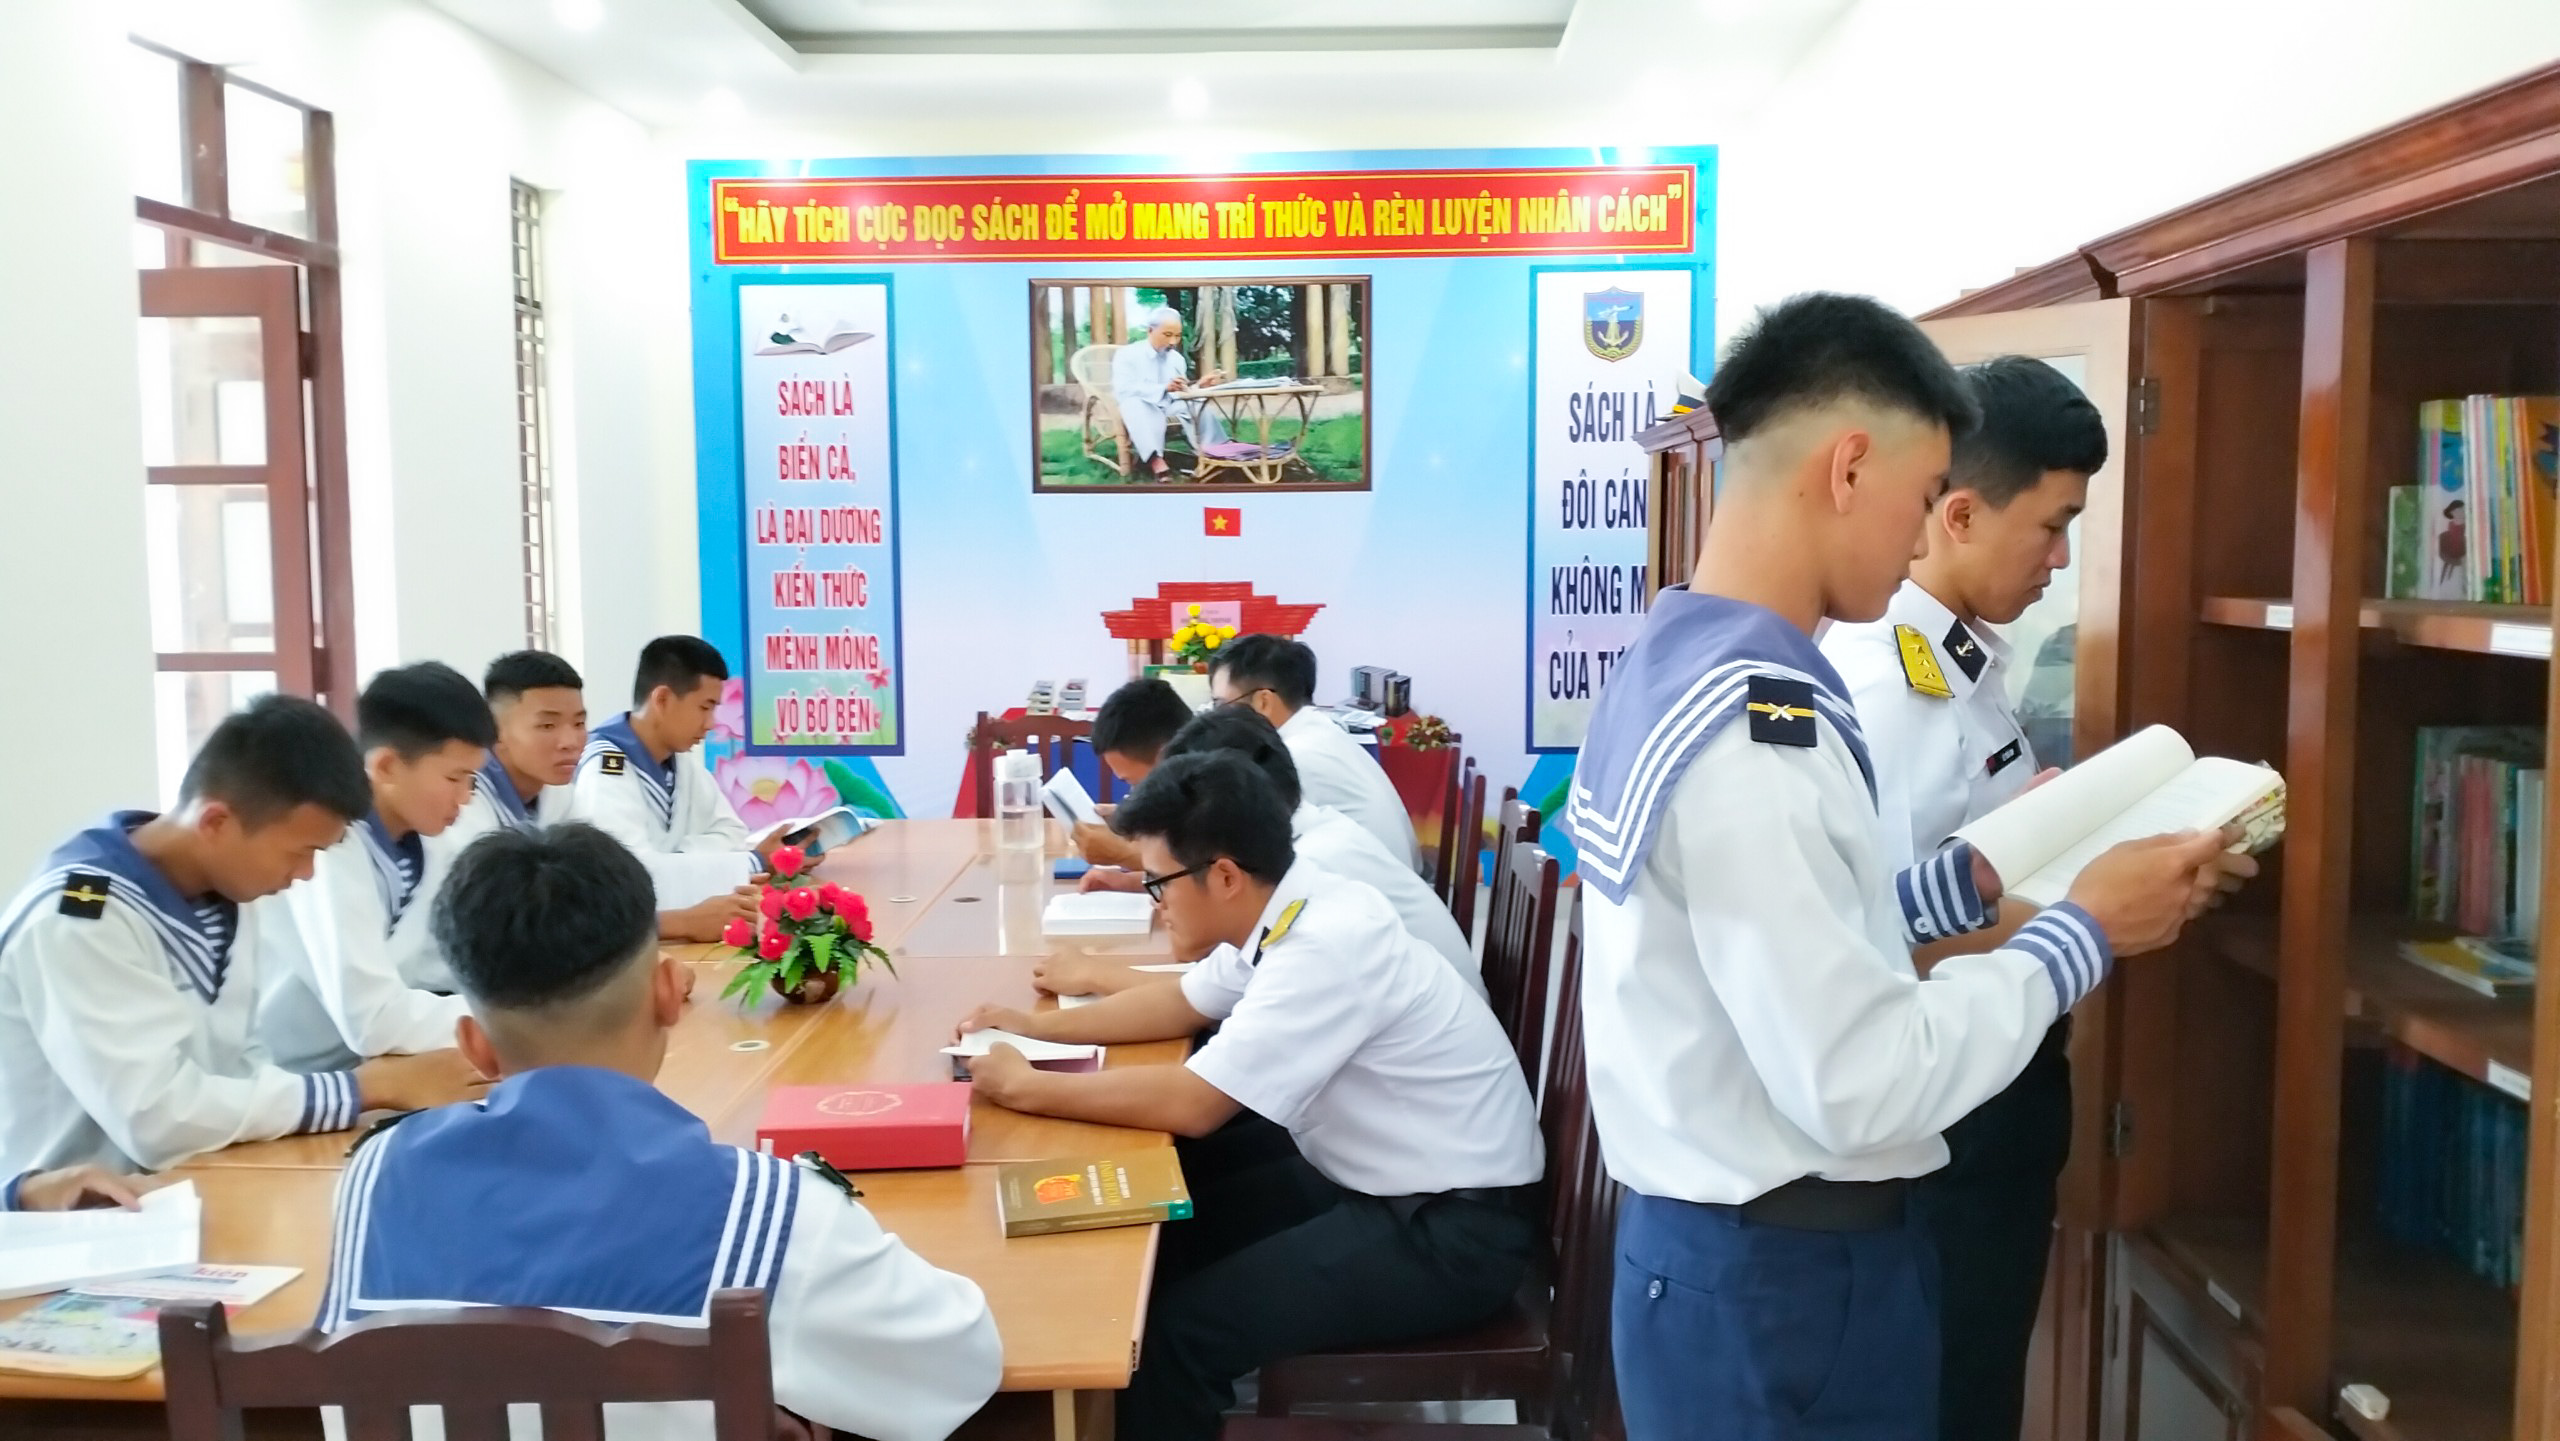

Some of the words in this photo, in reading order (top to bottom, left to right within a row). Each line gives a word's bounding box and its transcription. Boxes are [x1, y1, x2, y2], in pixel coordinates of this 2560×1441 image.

[793, 198, 849, 242] TÍCH
[856, 201, 908, 250] CỰC
[914, 204, 965, 250] ĐỌC
[971, 196, 1040, 241] SÁCH
[1045, 188, 1079, 240] ĐỂ
[1085, 190, 1128, 240] MỞ
[1133, 202, 1209, 240] MANG
[1215, 193, 1256, 239] TRÍ
[1261, 192, 1327, 238] THỨC
[1333, 191, 1367, 237] VÀ
[1373, 191, 1425, 236] RÈN
[1431, 189, 1511, 243] LUYỆN
[1519, 188, 1591, 234] NHÂN
[778, 372, 826, 416] SÁCH
[832, 372, 853, 416] LÀ
[1569, 381, 1625, 443] SÁCH
[1632, 379, 1657, 434] LÀ
[1562, 468, 1596, 529] ĐÔI
[1605, 467, 1647, 529] CÁN
[757, 501, 778, 544] LÀ
[784, 508, 814, 552] ĐẠI
[821, 505, 882, 544] DƯƠNG
[774, 560, 816, 608] KIẾN
[822, 564, 867, 608] THỨC
[1551, 555, 1622, 615] KHÔNG
[1630, 565, 1648, 615] M
[767, 628, 819, 670] MÊNH
[825, 628, 879, 670] MÔNG
[1550, 629, 1590, 700] CỦA
[777, 690, 799, 733] VÔ
[836, 687, 870, 733] BẾN
